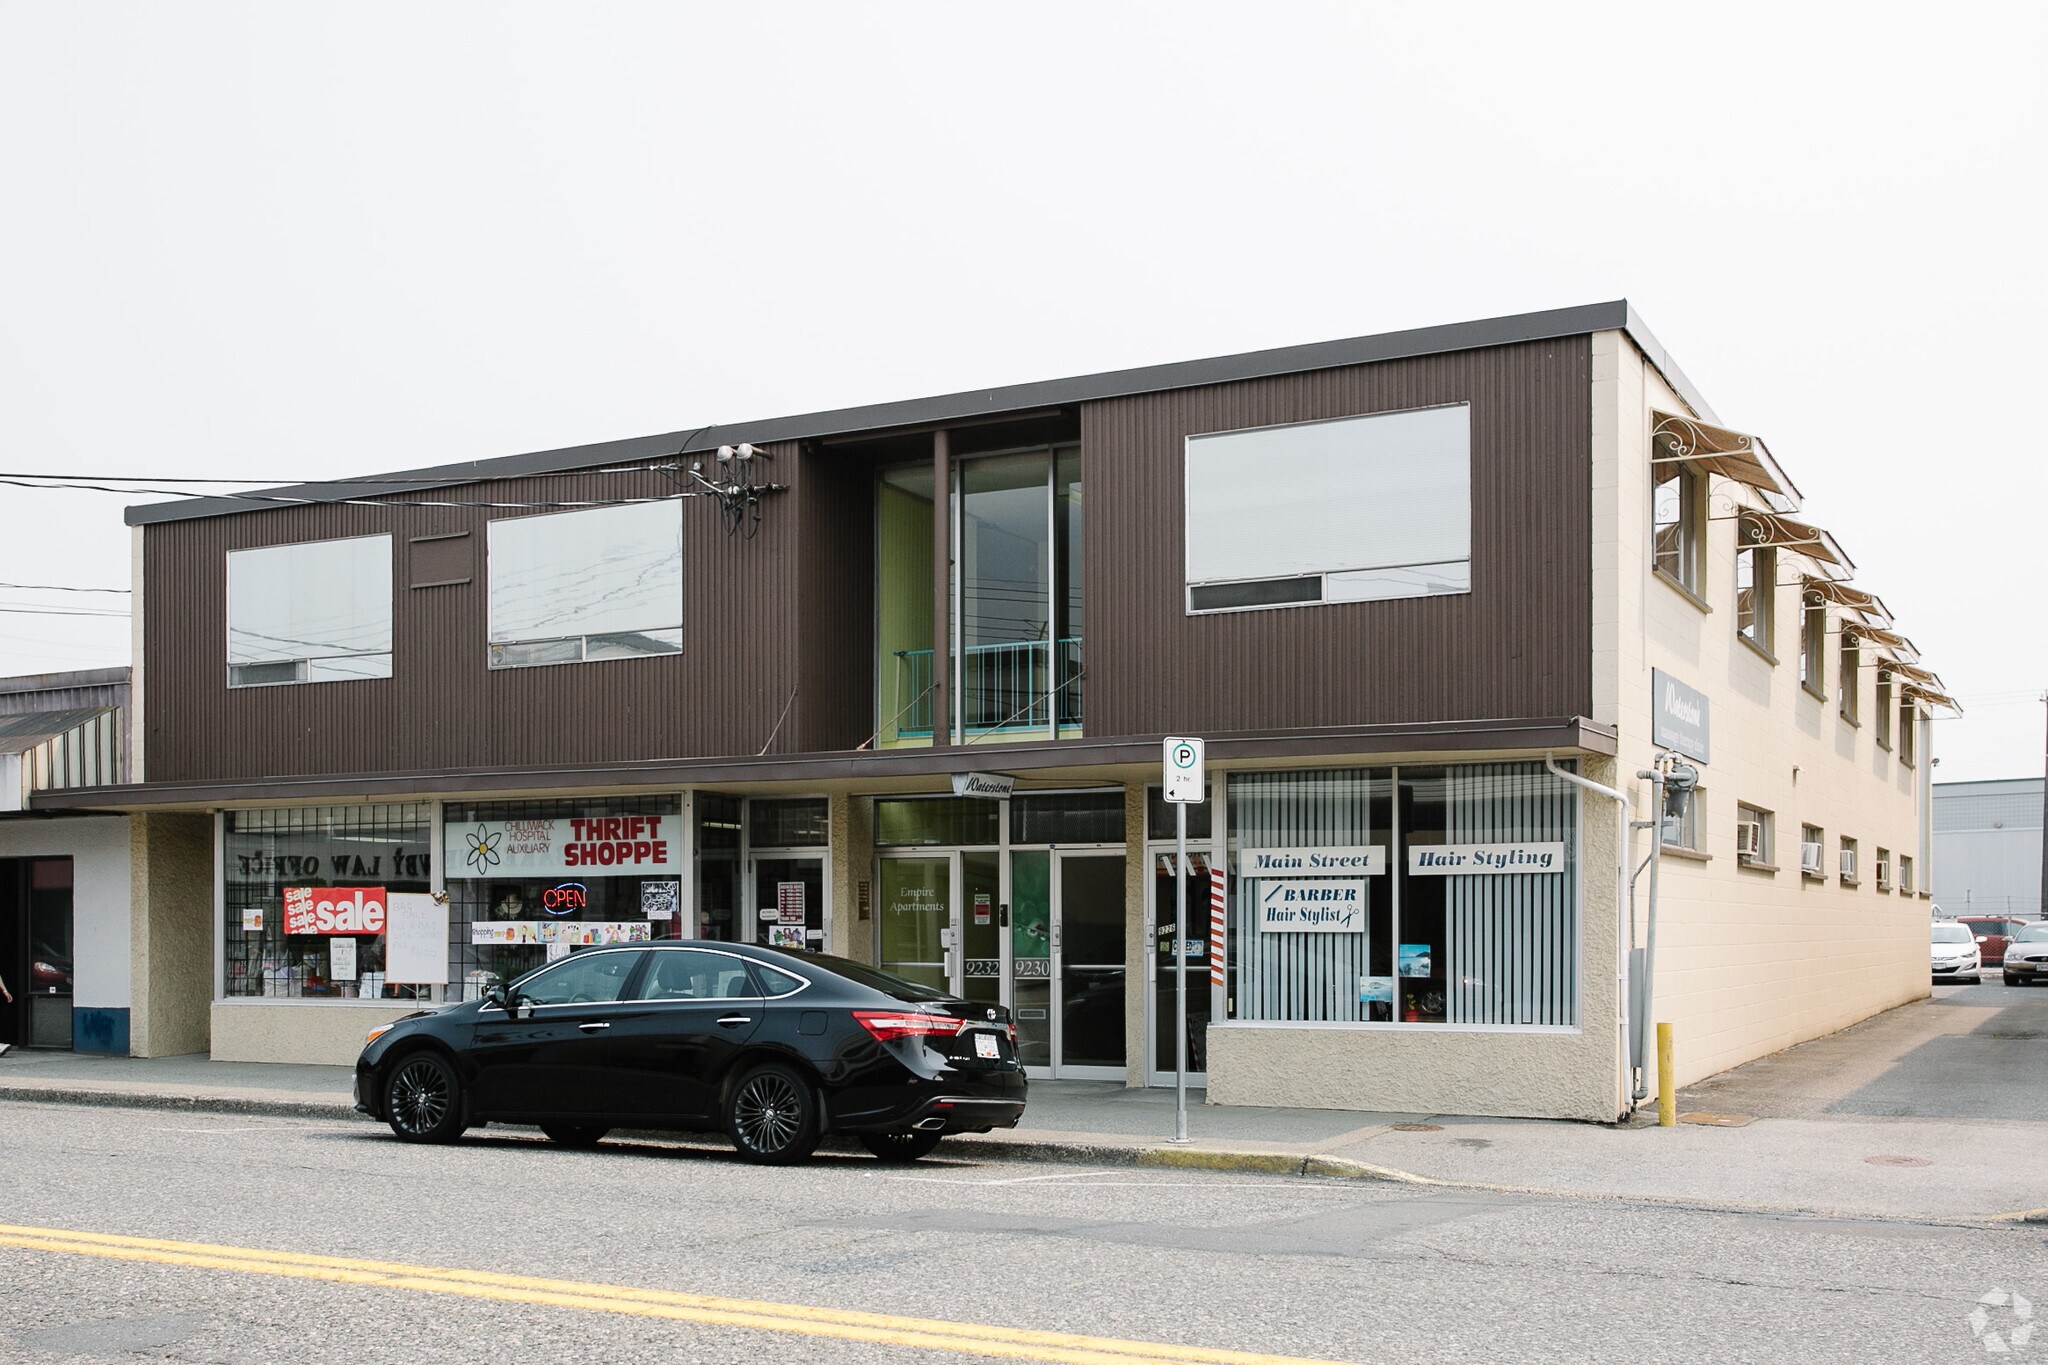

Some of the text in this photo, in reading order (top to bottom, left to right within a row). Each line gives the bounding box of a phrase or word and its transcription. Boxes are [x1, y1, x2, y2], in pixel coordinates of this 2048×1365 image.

[1179, 749, 1190, 763] P
[965, 777, 1012, 793] Waterstone
[1176, 775, 1181, 783] 2
[504, 819, 555, 832] CHILLIWACK
[571, 816, 661, 841] THRIFT
[509, 830, 552, 842] HOSPITAL
[506, 842, 551, 855] AUXILIARY
[564, 841, 668, 867] SHOPPE
[1254, 852, 1371, 870] Main Street
[1417, 848, 1554, 870] Hair Styling
[286, 888, 313, 902] sale
[543, 889, 586, 908] OPEN
[900, 887, 935, 902] Empire
[1284, 888, 1356, 902] BARBER
[287, 900, 314, 915] sale
[316, 891, 384, 931] sale
[889, 901, 944, 917] Apartments
[289, 913, 316, 928] sale
[1266, 906, 1341, 926] Hair Stylist
[1173, 940, 1193, 951] CED
[966, 961, 999, 975] 9232
[1015, 960, 1050, 976] 9230
